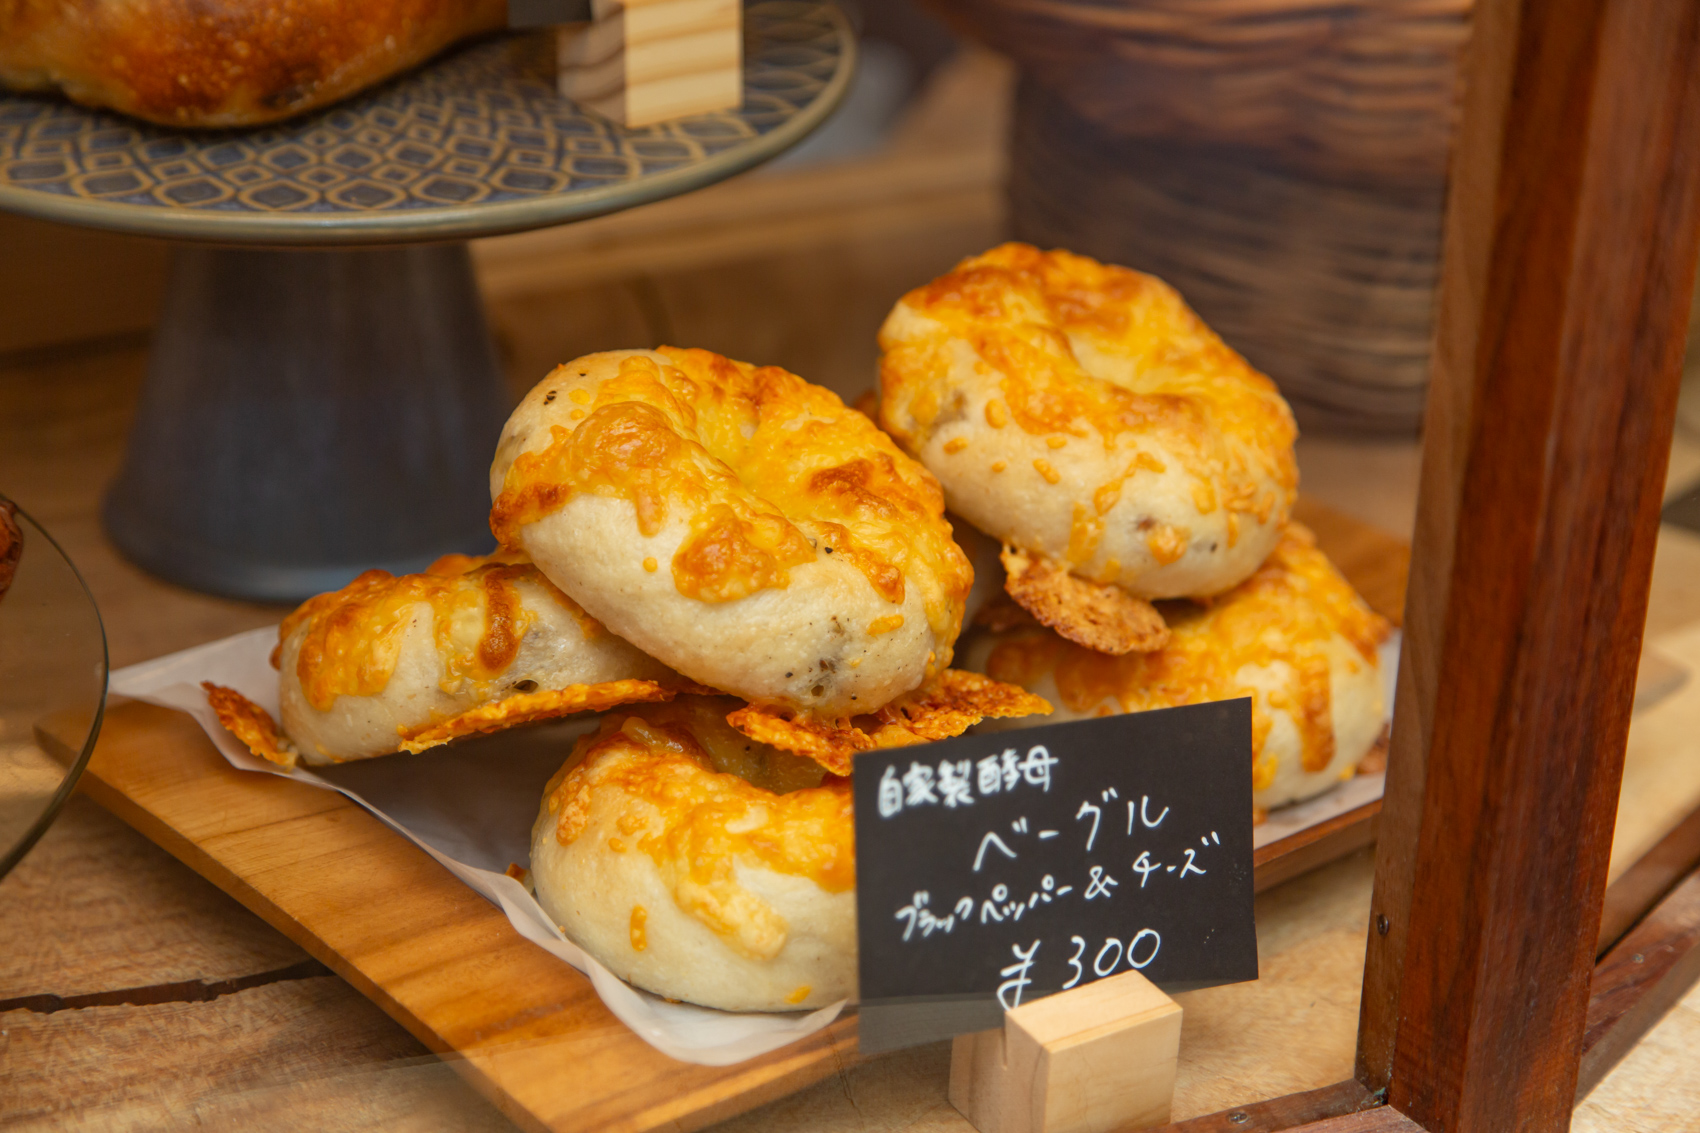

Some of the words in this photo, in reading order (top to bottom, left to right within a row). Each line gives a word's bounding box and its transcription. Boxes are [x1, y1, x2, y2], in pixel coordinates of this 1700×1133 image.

[878, 744, 1059, 818] 自家製酵母
[972, 787, 1170, 872] ベーグル
